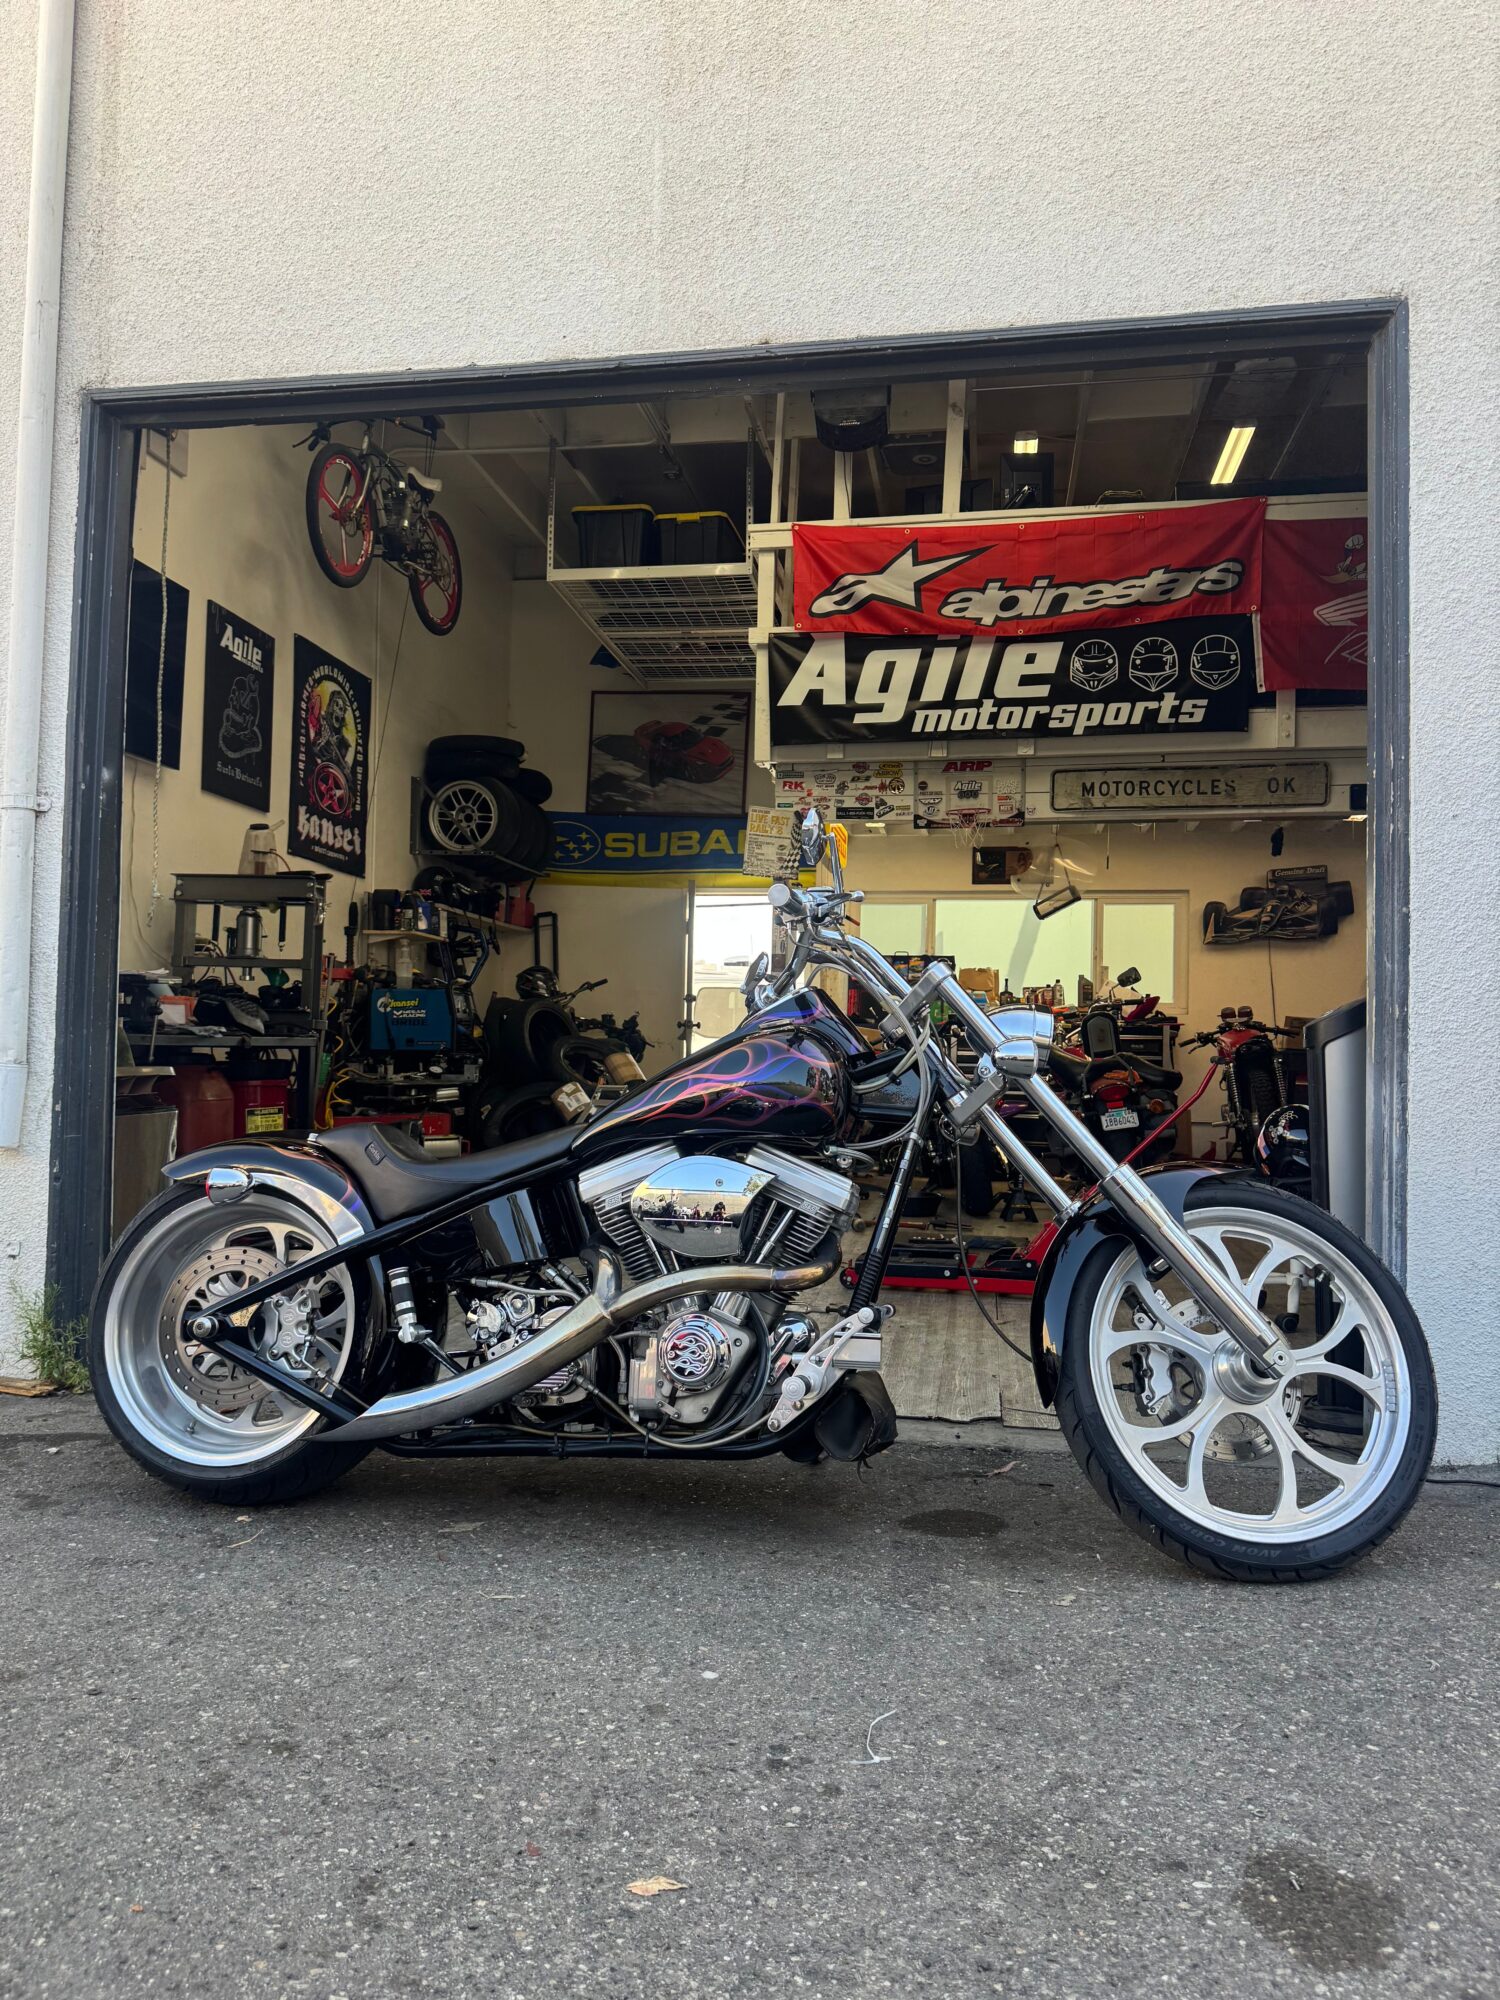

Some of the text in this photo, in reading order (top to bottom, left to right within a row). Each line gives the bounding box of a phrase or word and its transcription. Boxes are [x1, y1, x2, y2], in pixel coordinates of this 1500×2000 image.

[940, 560, 1244, 627] alpinestars
[220, 622, 262, 666] Agile
[777, 632, 1064, 724] Agile
[911, 692, 1208, 736] motorsports
[942, 760, 993, 772] ARP
[783, 780, 805, 790] RK
[954, 780, 982, 792] Agile
[1081, 777, 1296, 798] MOTORCYCLES OK
[750, 812, 790, 826] LIVE FAST
[749, 823, 776, 835] RALLY
[604, 829, 746, 858] SUBA
[1275, 866, 1326, 877] Genuine Draft
[1167, 1513, 1227, 1547] COBRA
[1232, 1544, 1280, 1558] AVON
